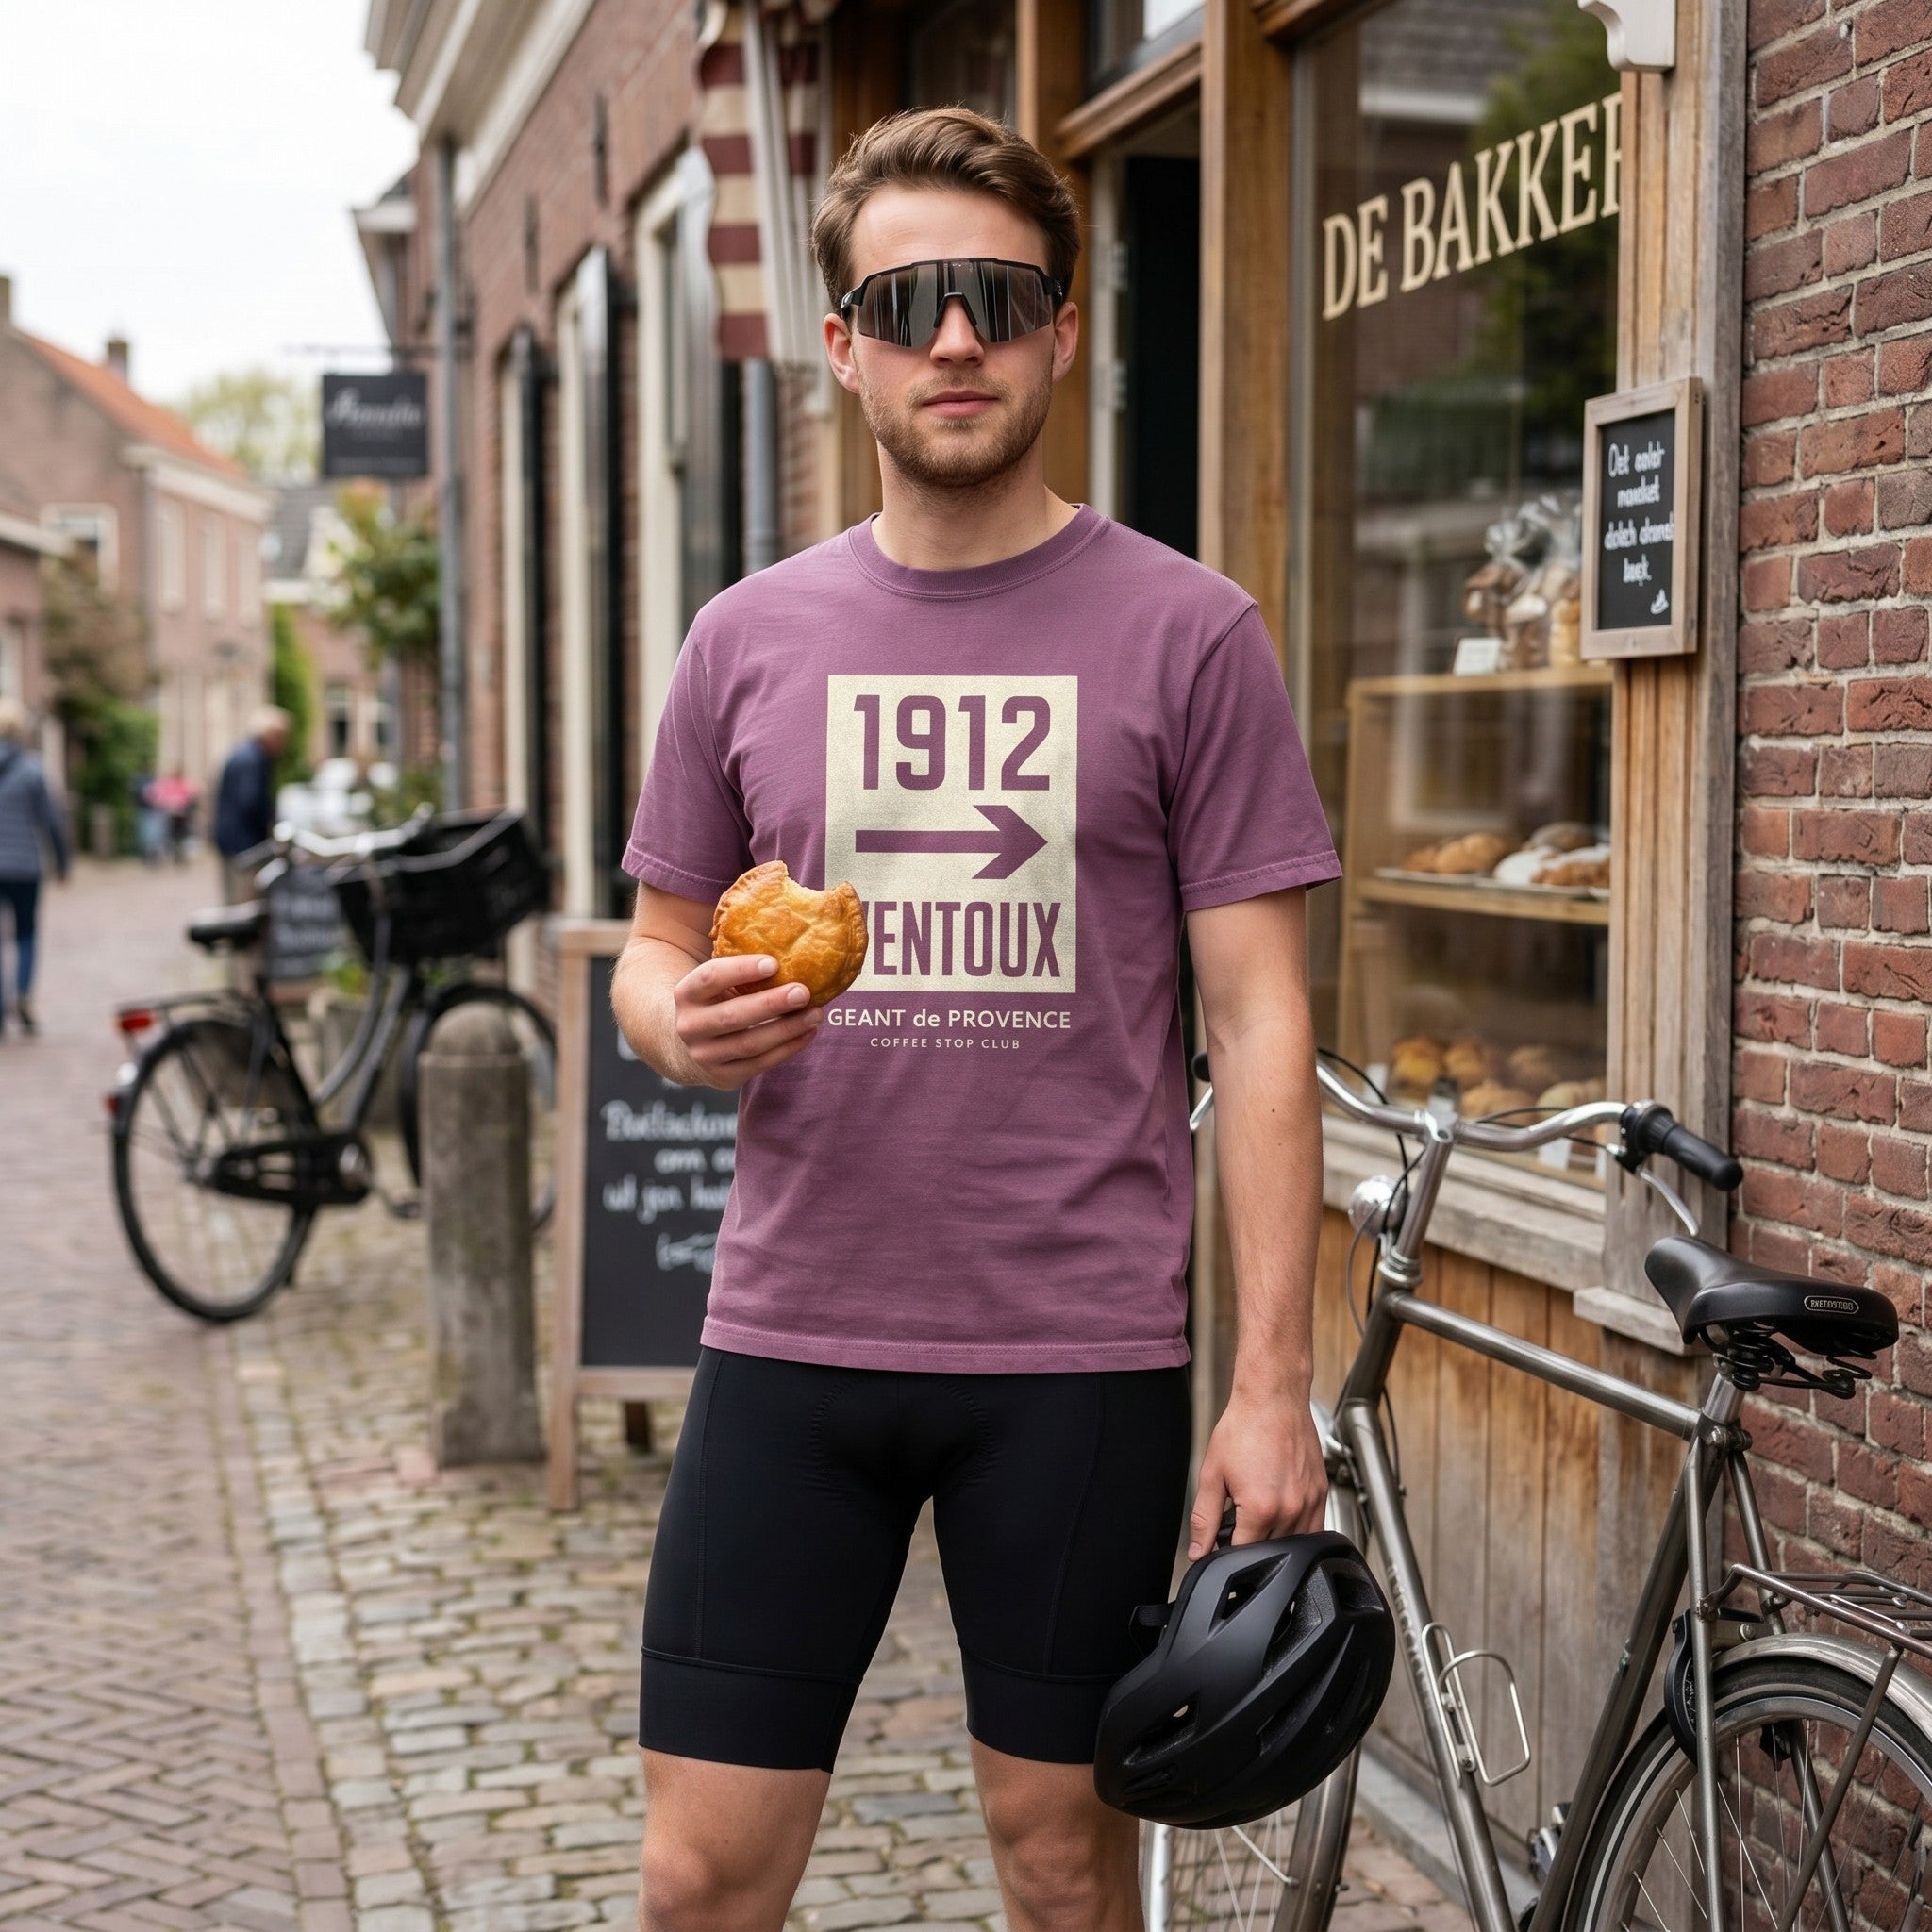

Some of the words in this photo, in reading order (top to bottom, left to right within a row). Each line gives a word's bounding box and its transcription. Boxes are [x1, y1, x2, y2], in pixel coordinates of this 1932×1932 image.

[1323, 194, 1389, 322] DE
[853, 694, 1051, 791] 1912
[858, 900, 1060, 977] ENTOUX
[827, 1008, 906, 1028] GEANT
[912, 1008, 941, 1028] de
[947, 1010, 1072, 1029] PROVENCE
[870, 1037, 928, 1048] COFFEE
[935, 1038, 974, 1049] STOP
[981, 1039, 1021, 1050] CLUB
